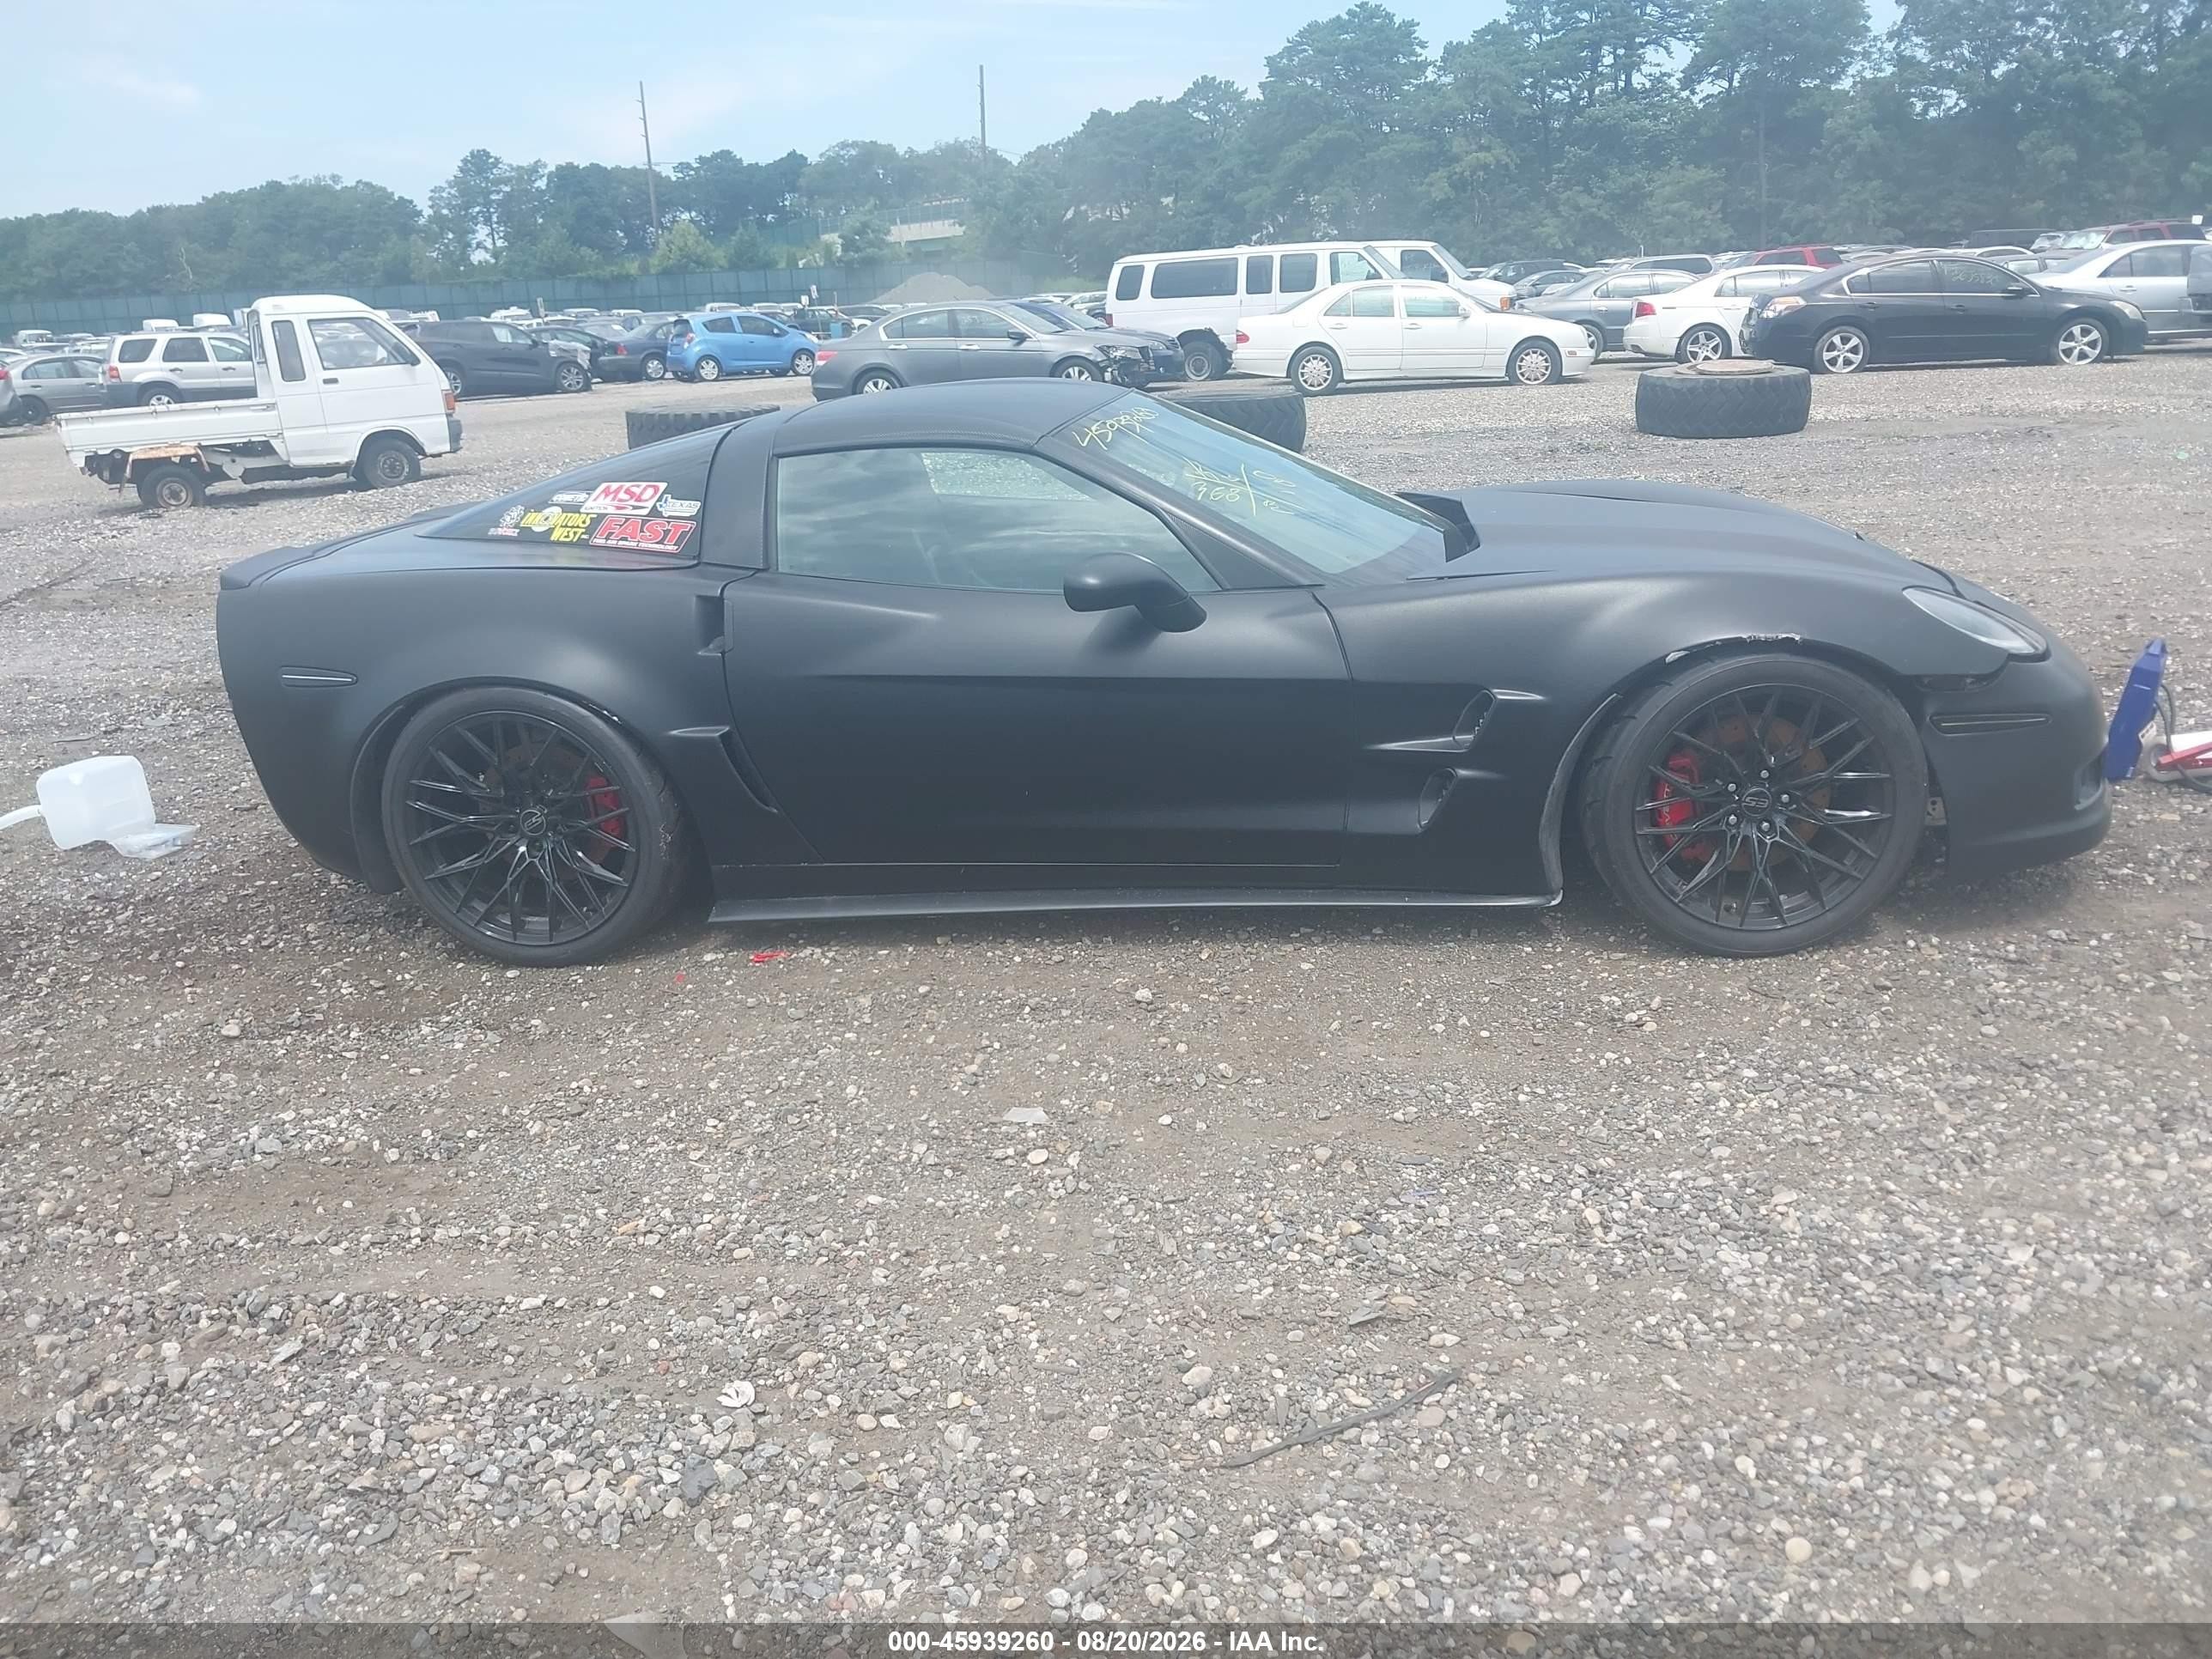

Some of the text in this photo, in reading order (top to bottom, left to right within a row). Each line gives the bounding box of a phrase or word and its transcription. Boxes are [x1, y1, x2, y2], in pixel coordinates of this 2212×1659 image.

[592, 483, 661, 503] MSD
[550, 526, 586, 543] WEST
[595, 516, 692, 545] FAST
